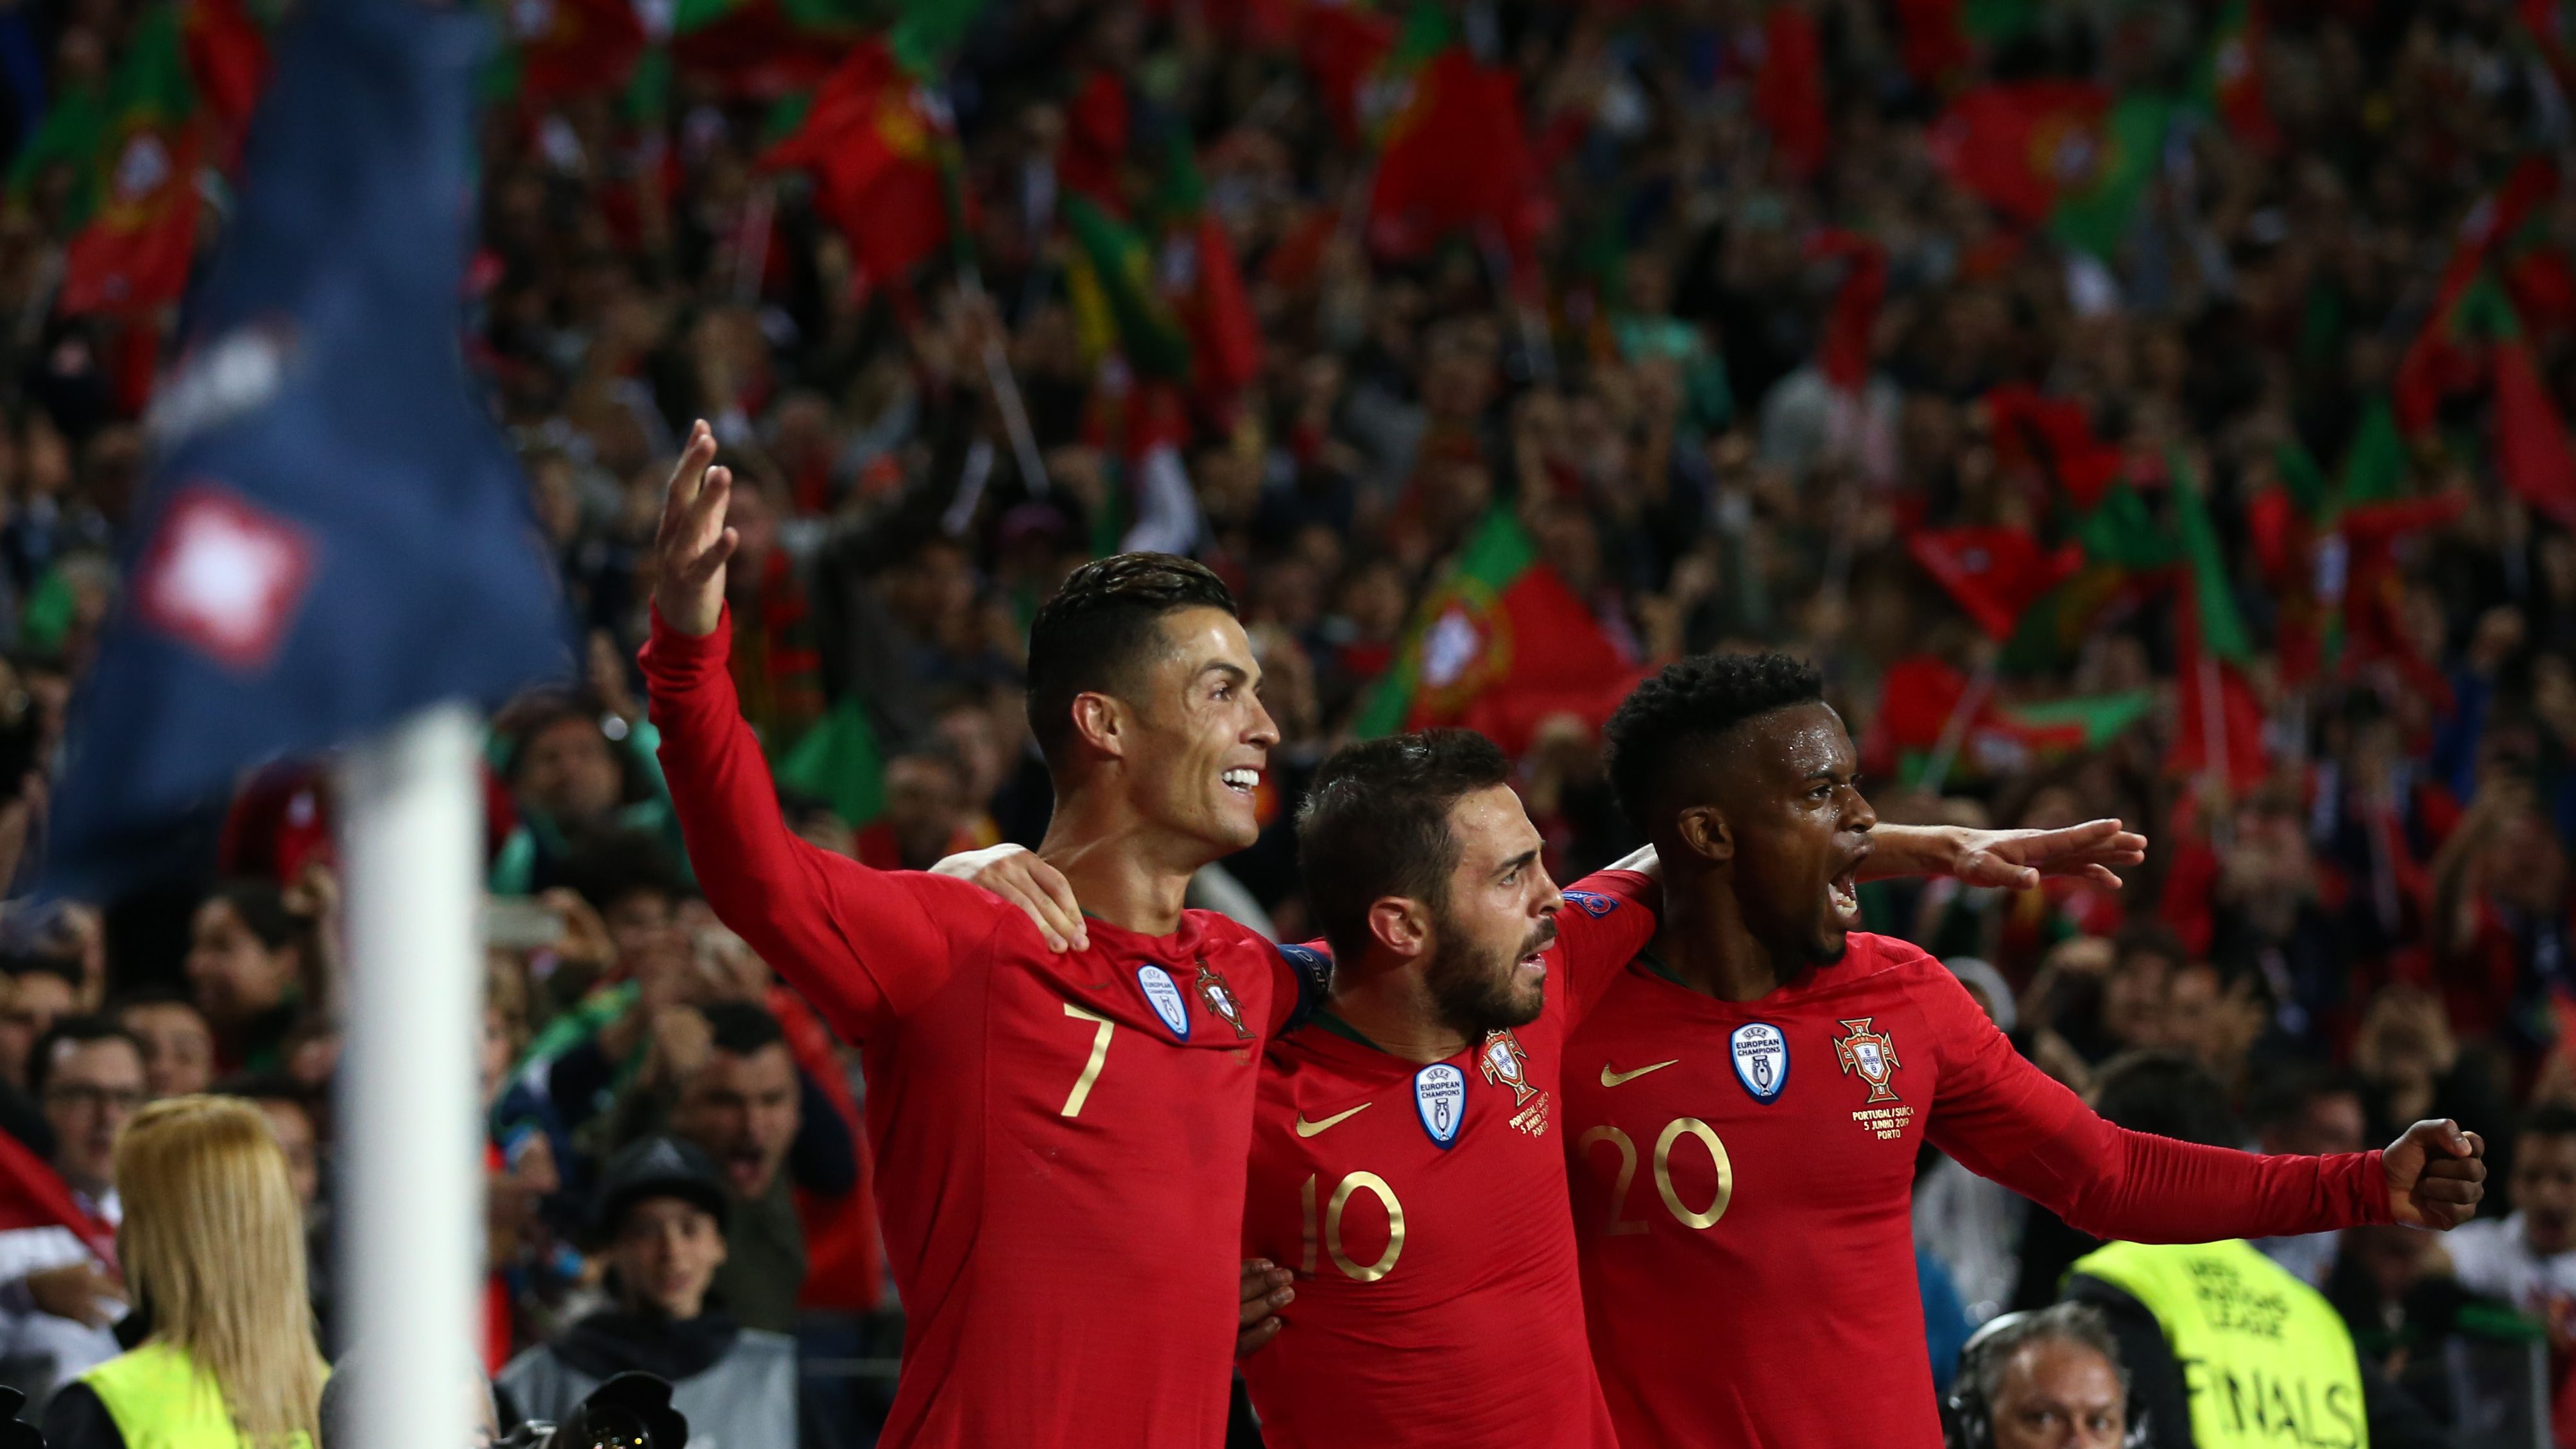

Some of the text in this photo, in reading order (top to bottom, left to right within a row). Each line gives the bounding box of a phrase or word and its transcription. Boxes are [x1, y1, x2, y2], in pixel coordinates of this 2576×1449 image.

[1744, 1027, 1767, 1038] UEFA
[1736, 1038, 1780, 1049] EUROPEAN
[1737, 1046, 1780, 1056] CHAMPIONS
[1061, 1002, 1114, 1117] 7
[1428, 1068, 1451, 1081] UEFA
[1420, 1081, 1460, 1091] EUROPEAN
[1421, 1089, 1460, 1099] CHAMPIONS
[1520, 1125, 1527, 1134] 5
[1532, 1120, 1549, 1138] PORTO
[1864, 1118, 1909, 1131] 5 JUNHO 2019
[1877, 1129, 1901, 1140] PORTO
[1578, 1117, 1733, 1235] 20
[1300, 1170, 1405, 1282] 10
[2179, 1355, 2360, 1449] FINALS
